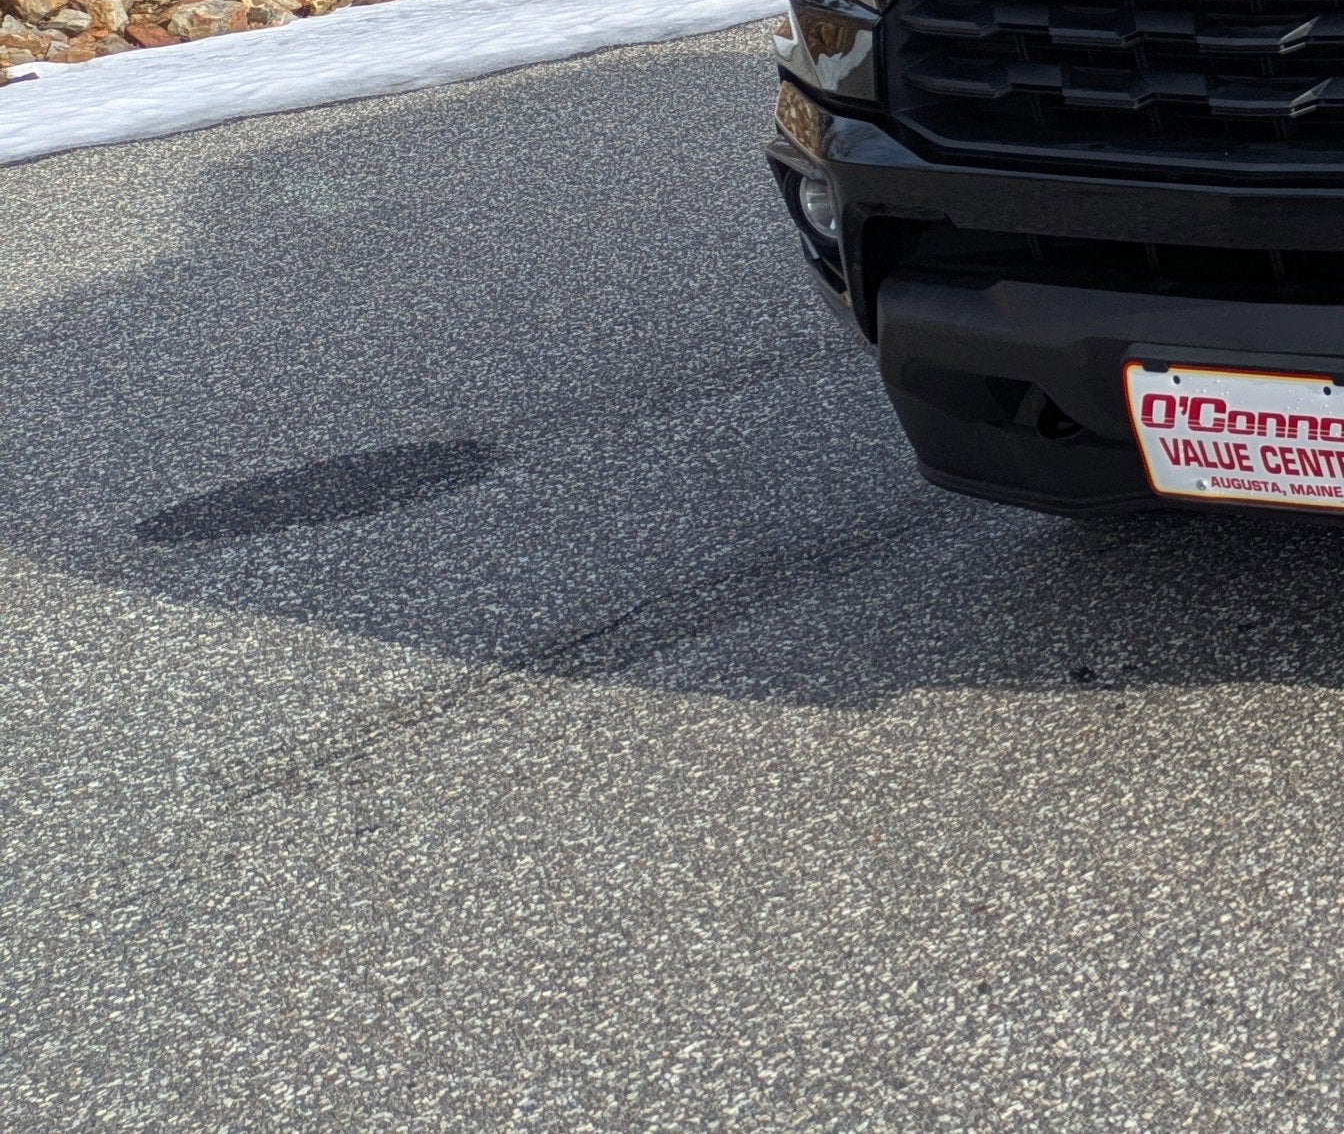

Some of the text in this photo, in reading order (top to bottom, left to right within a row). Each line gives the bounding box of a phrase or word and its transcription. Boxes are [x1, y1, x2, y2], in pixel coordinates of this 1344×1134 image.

[1159, 437, 1254, 472] VALUE
[1210, 476, 1344, 498] AUGUSTA, MAINE
